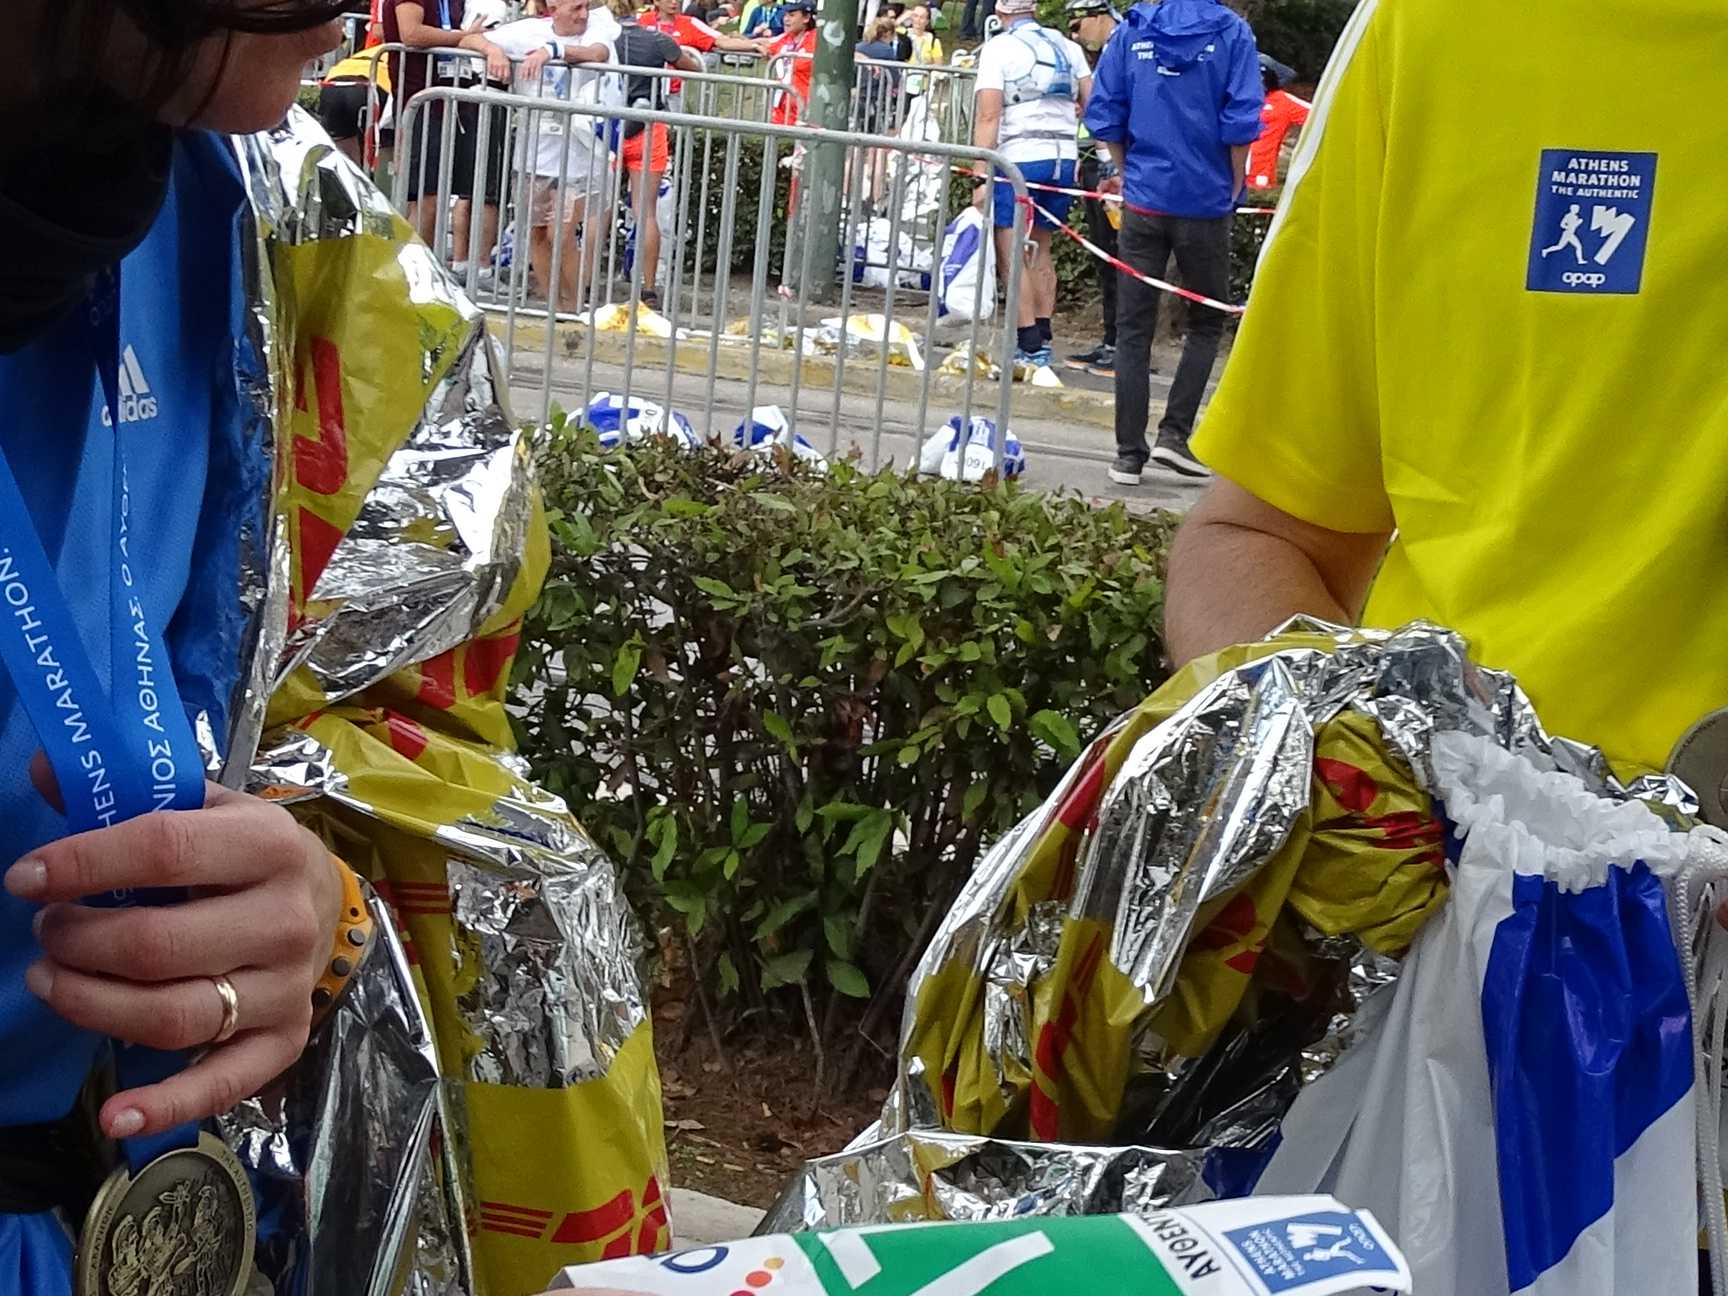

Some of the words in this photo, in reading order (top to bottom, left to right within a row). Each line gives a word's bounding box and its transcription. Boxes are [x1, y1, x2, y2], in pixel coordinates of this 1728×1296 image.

[1568, 158, 1629, 172] ATHENS
[1552, 171, 1641, 187] MARATHON
[1552, 185, 1573, 196] THE
[1576, 188, 1639, 199] AUTHENTIC
[1562, 271, 1606, 288] opap
[80, 749, 115, 827] HENS
